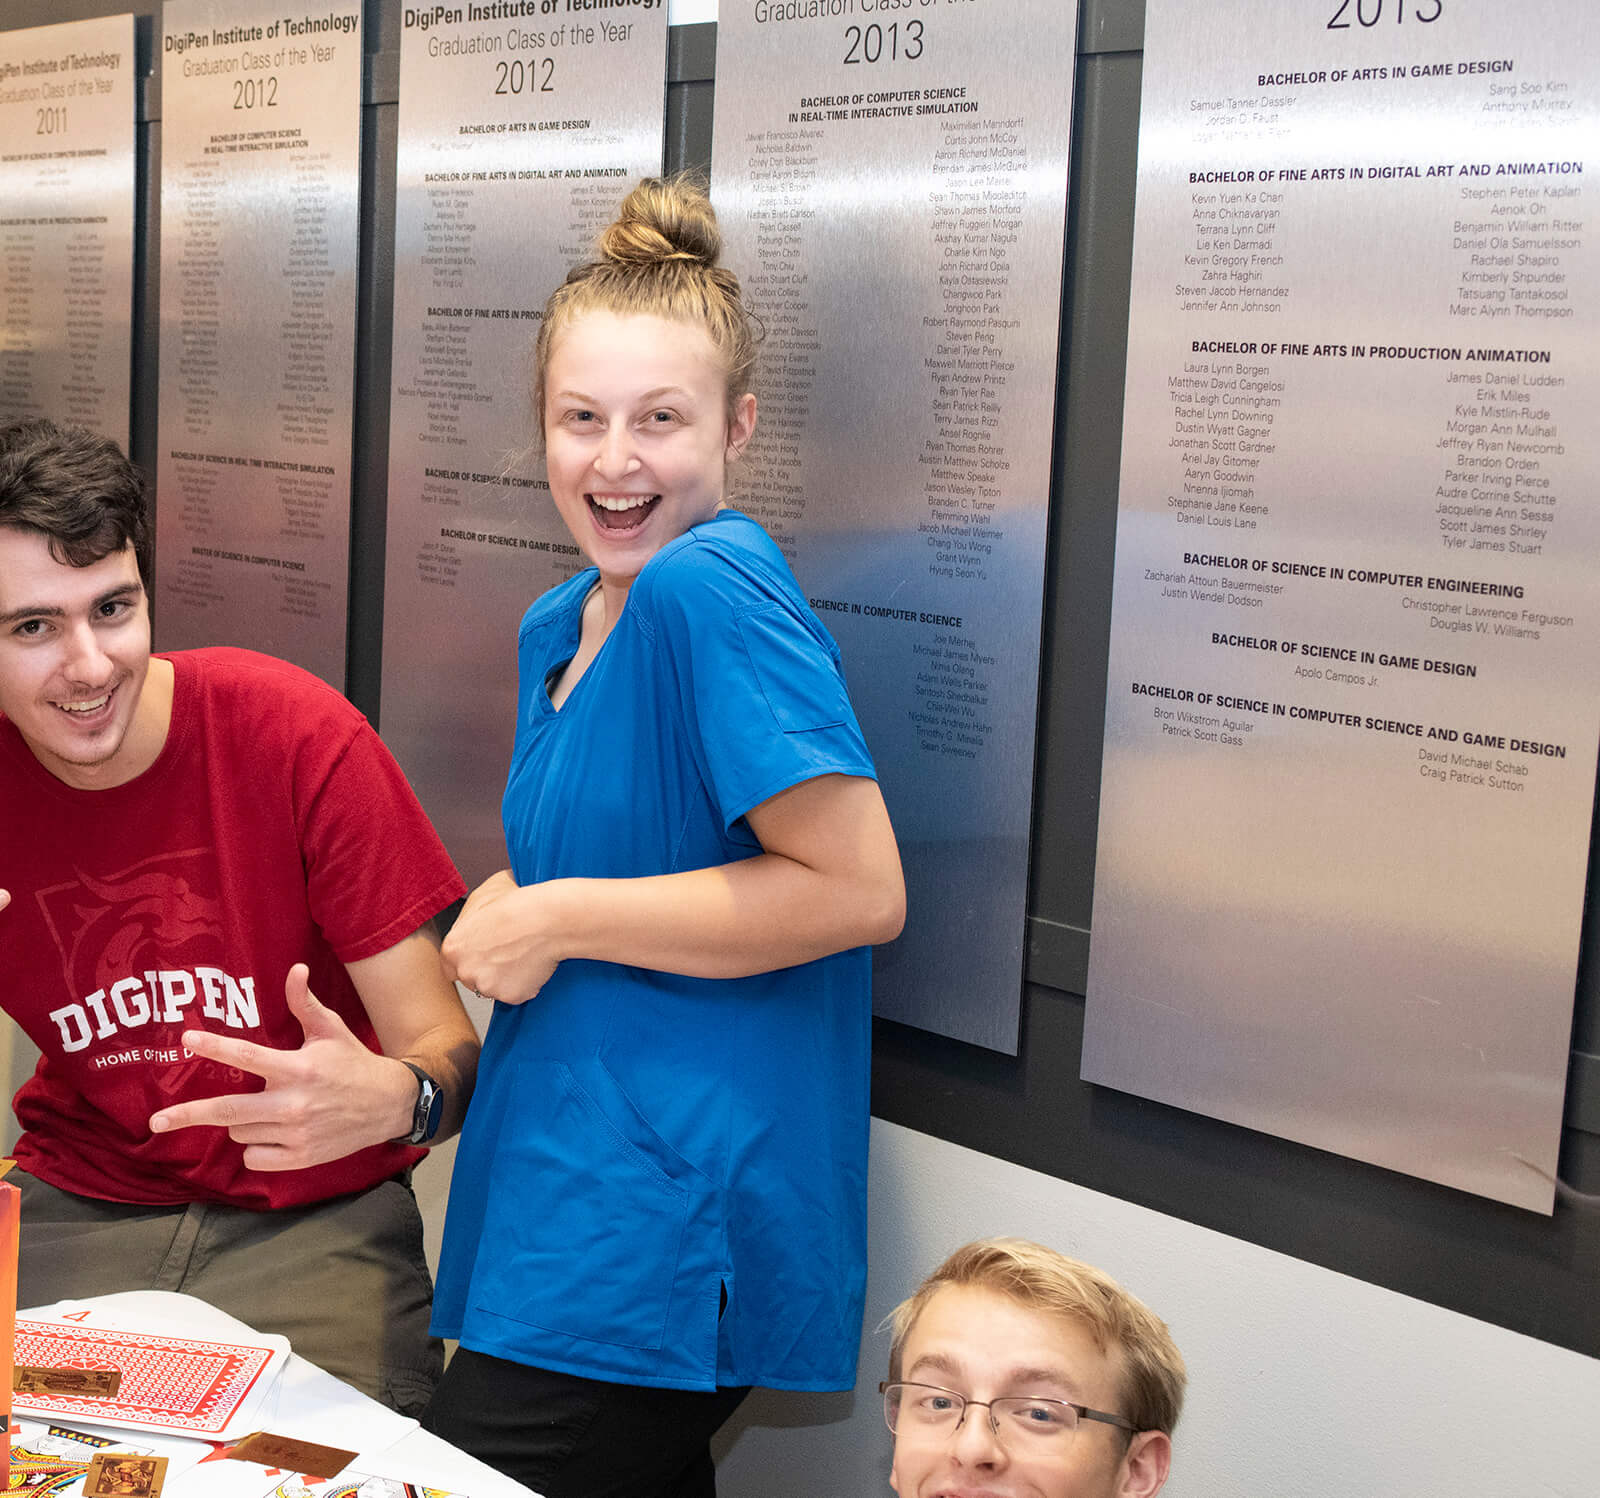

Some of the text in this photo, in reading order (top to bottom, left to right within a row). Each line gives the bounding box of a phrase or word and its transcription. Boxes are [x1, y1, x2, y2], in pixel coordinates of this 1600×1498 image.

[405, 7, 462, 31] DigiPen
[468, 1, 534, 21] Institute
[755, 0, 854, 23] Graduation
[165, 13, 359, 54] DigiPen Institute of Technology
[428, 20, 634, 57] Graduation Class of the Year
[843, 19, 925, 64] 2013
[23, 60, 58, 76] Institute
[69, 50, 121, 71] Technology
[183, 44, 336, 77] Graduation Class of the Year
[1258, 60, 1513, 86] BACHELOR OF ARTS IN GAME DESIGN
[495, 58, 554, 94] 2012
[233, 76, 278, 109] 2012
[801, 87, 966, 108] BACHELOR OF COMPUTER SCIENCE
[36, 107, 67, 135] 2011
[789, 101, 978, 123] IN REAL-TIME INTERACTIVE SIMULATION
[1189, 162, 1582, 184] BACHELOR OF FINE ARTS IN DIGITAL ART AND ANIMATION
[1184, 254, 1283, 268] Kevin Gregory French
[1192, 341, 1550, 363] BACHELOR OF FINE ARTS IN PRODUCTION ANIMATION
[1168, 437, 1276, 454] Jonathan Scott Gardner
[1457, 454, 1540, 471] Brandon Orden
[1177, 511, 1257, 529] Daniel Louis Lane
[1183, 552, 1524, 599] BACHELOR OF SCIENCE IN COMPUTER ENGINEERING
[1161, 586, 1263, 607] Justin Wendel Dodson
[810, 598, 962, 628] SCIENCE IN COMPUTER SCIENCE
[1429, 616, 1540, 640] Douglas W. Williams
[1212, 632, 1476, 677] BACHELOR OF SCIENCE IN GAME DESIGN
[1132, 683, 1566, 758] BACHELOR OF SCIENCE IN COMPUTER SCIENCE AND GAME DESIGN
[1418, 748, 1529, 776] David Michael Schab
[49, 967, 260, 1053] DIGIPEN
[96, 1049, 141, 1068] HOME
